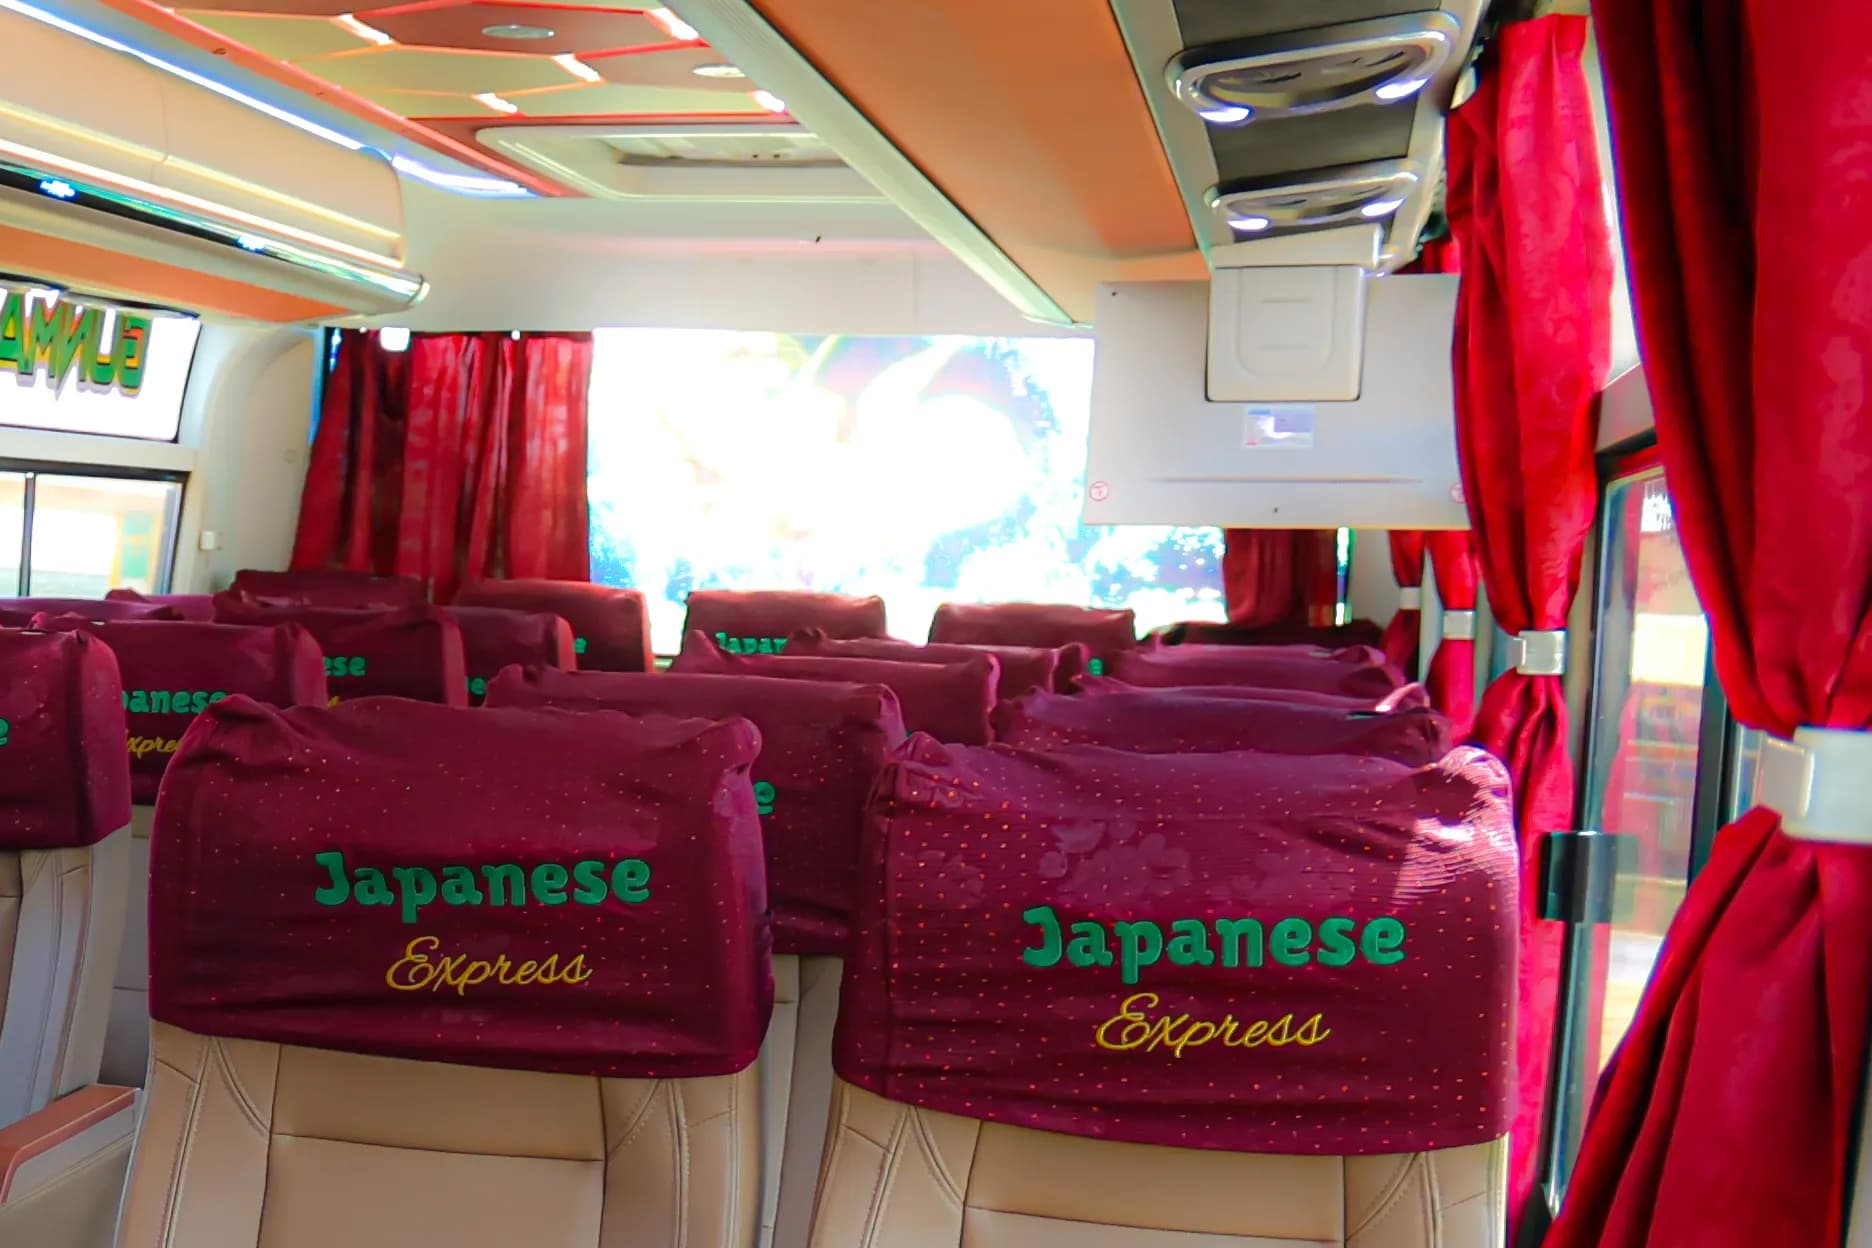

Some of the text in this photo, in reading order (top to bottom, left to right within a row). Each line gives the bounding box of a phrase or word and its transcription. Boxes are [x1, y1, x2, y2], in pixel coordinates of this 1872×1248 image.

[123, 689, 227, 713] anes
[314, 851, 652, 924] Japanese
[386, 935, 593, 997] Express
[1022, 905, 1407, 985] Japanese
[1095, 992, 1331, 1058] Express
